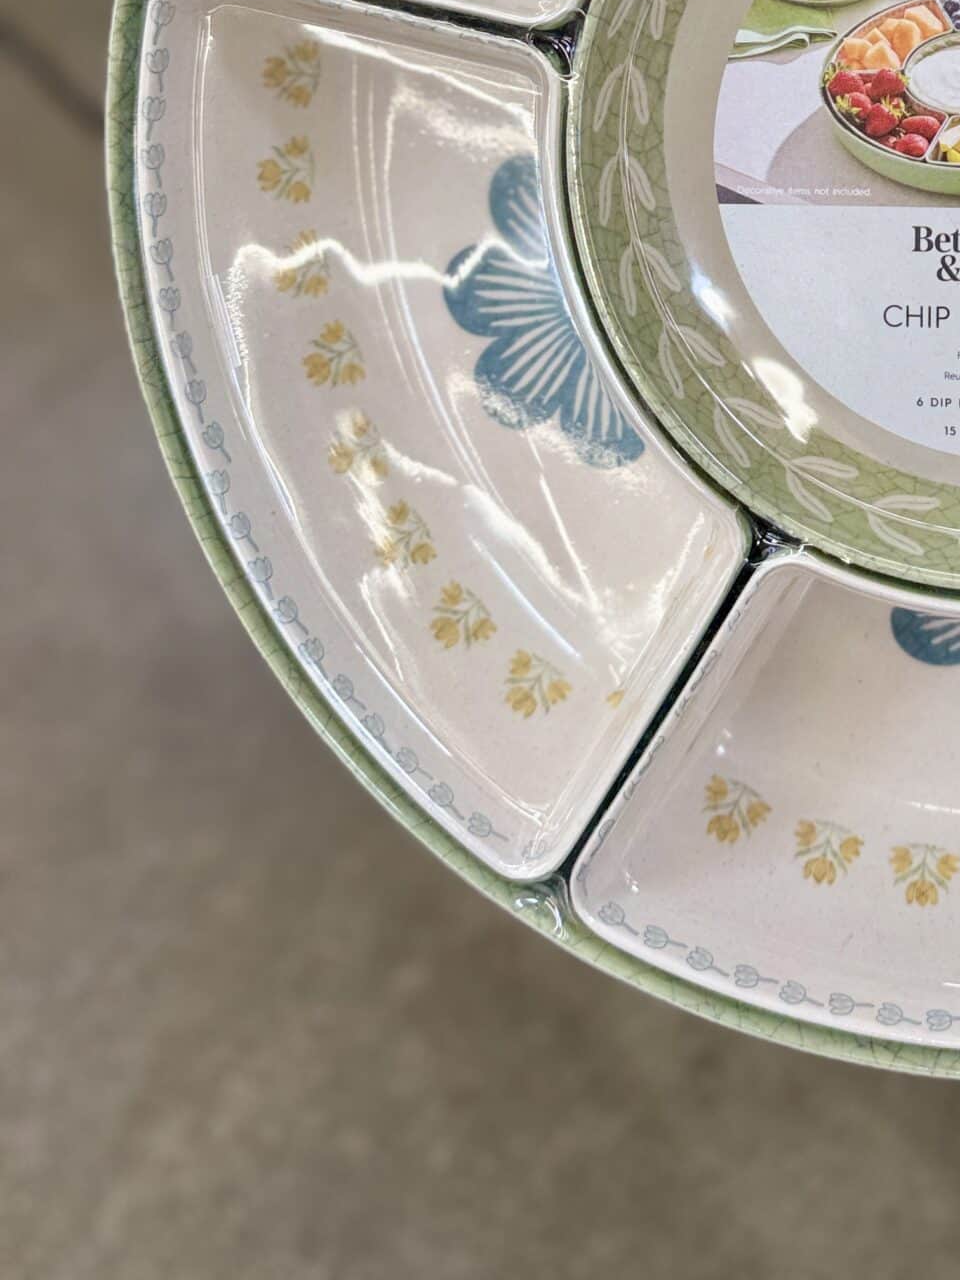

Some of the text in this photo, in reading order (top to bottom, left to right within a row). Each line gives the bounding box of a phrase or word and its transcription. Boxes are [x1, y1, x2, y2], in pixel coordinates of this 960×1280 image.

[883, 304, 950, 329] CHIP
[916, 397, 924, 408] 6
[930, 398, 952, 409] DIP
[944, 426, 957, 437] 15
